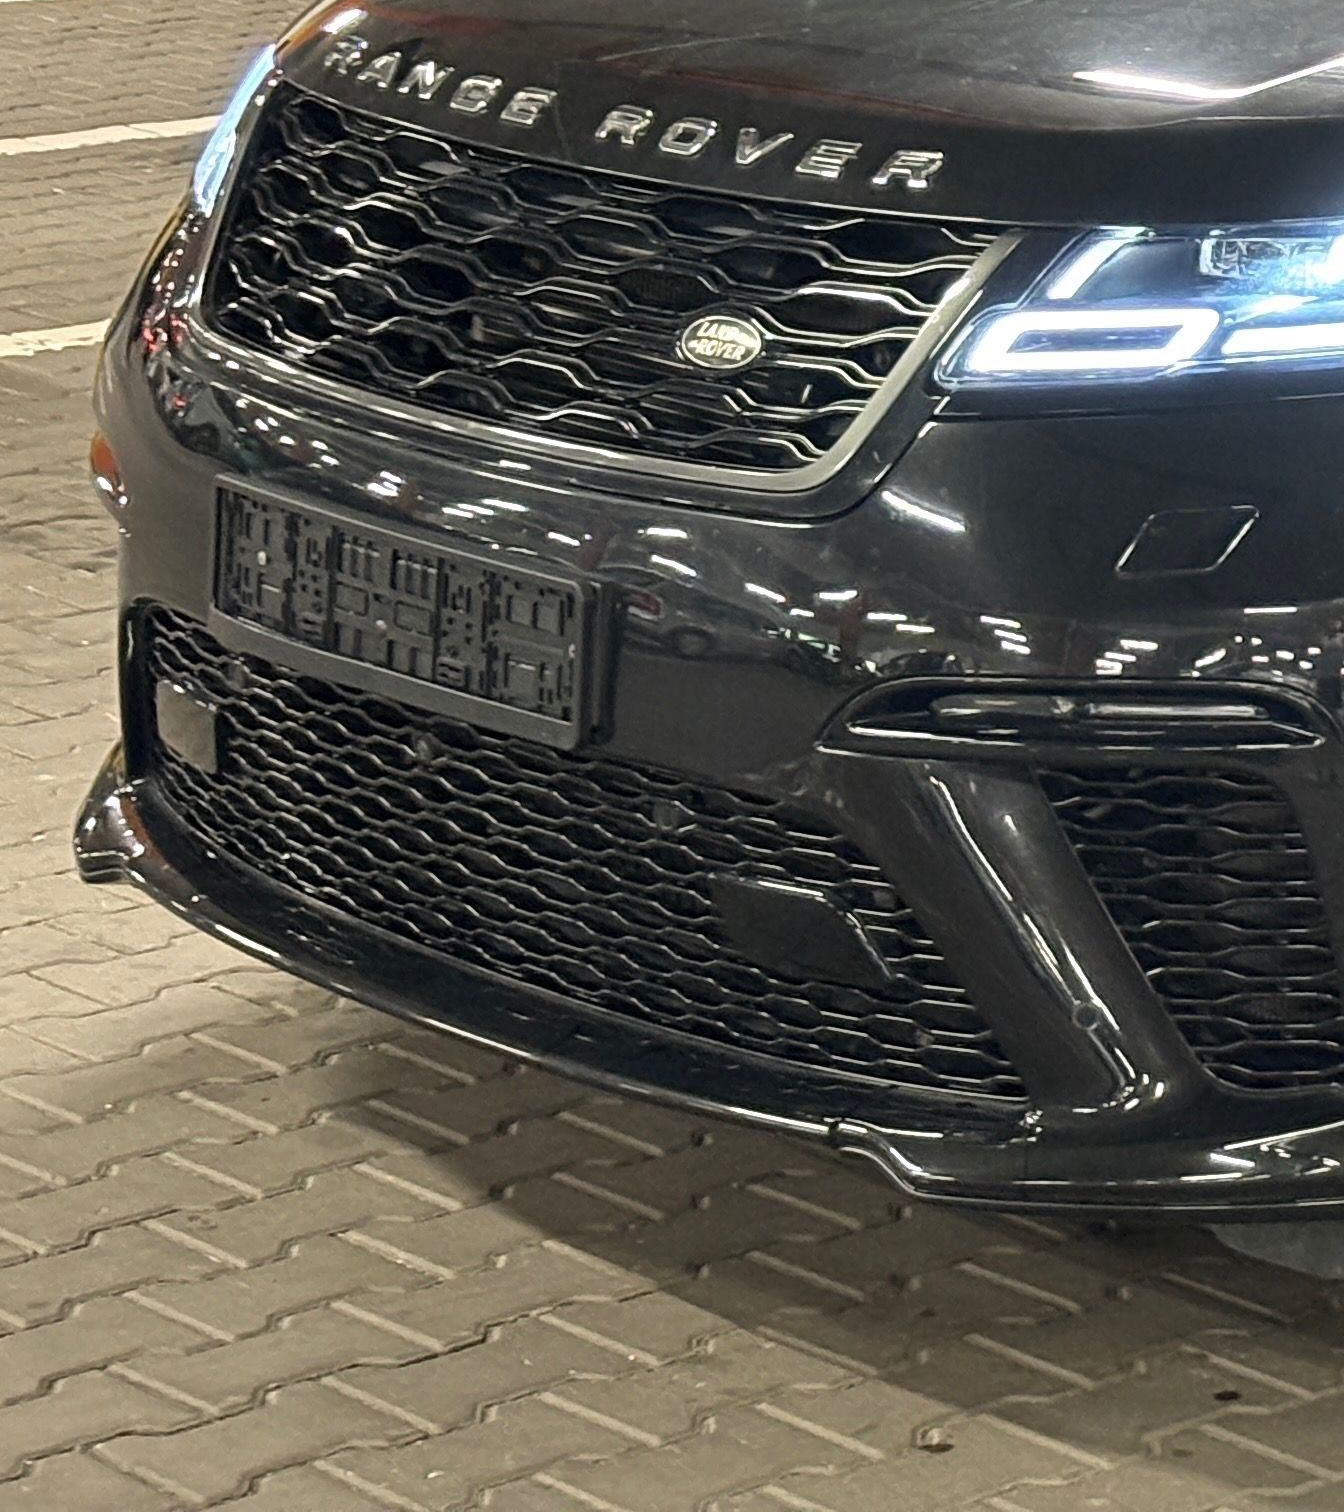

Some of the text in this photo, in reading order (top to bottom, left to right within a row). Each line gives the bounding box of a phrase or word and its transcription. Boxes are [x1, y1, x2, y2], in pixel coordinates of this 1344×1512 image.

[325, 36, 945, 189] RANGE ROVER
[697, 321, 740, 341] LAND
[695, 338, 746, 361] ROVER
